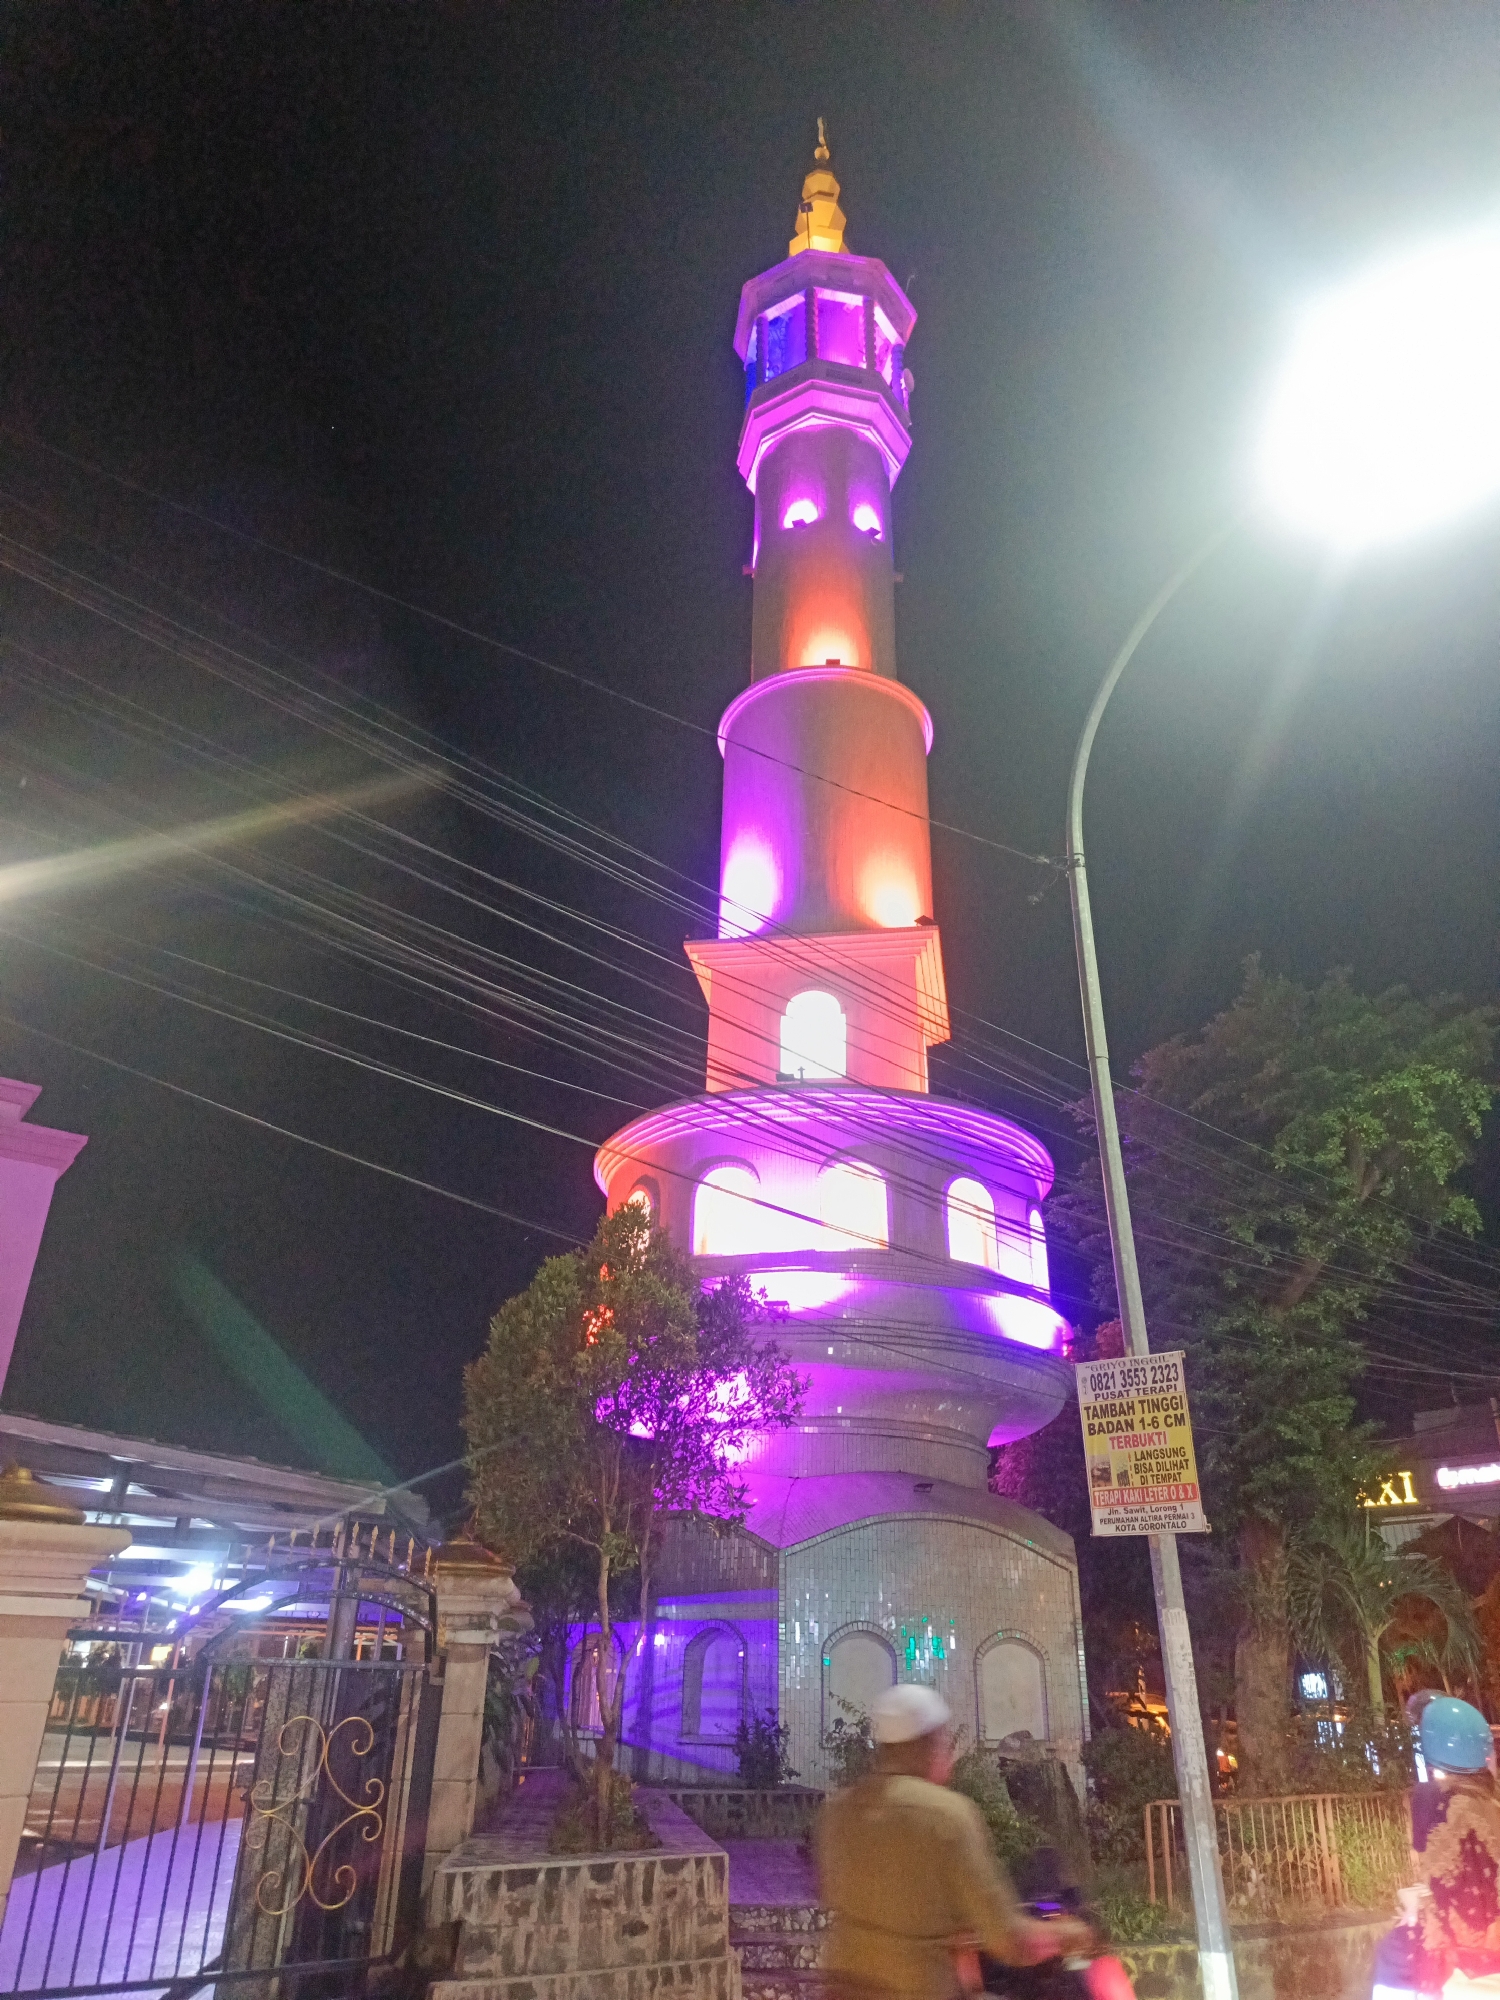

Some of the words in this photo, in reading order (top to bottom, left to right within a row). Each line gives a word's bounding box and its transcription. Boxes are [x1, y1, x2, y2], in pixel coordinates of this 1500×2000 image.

[1090, 1371, 1116, 1392] 0821
[1120, 1367, 1147, 1388] 3553
[1151, 1363, 1179, 1384] 2323
[1094, 1389, 1131, 1401] PUSAT
[1135, 1384, 1178, 1396] TERAPI
[1084, 1400, 1135, 1421] TAMBAH
[1138, 1395, 1184, 1414] TINGGI
[1087, 1419, 1135, 1436] BADAN
[1139, 1416, 1160, 1430] 1-6
[1163, 1413, 1186, 1428] CM
[1109, 1431, 1167, 1450] TERBUKTI
[1134, 1446, 1186, 1461] LANGSUNG
[1134, 1463, 1154, 1474] BISA
[1156, 1459, 1189, 1472] DILIHAT
[1140, 1477, 1149, 1485] DI
[1151, 1472, 1182, 1484] TEMPAT
[1094, 1490, 1121, 1506] TERAPI
[1125, 1489, 1142, 1503] KAKI
[1145, 1487, 1168, 1502] LETER
[1178, 1486, 1185, 1500] &
[1187, 1484, 1194, 1498] X
[1150, 1504, 1177, 1514] Lorong
[1179, 1503, 1184, 1511] 1
[1100, 1517, 1138, 1525] PERUMAHAN
[1141, 1515, 1163, 1523] ALTIRA
[1165, 1513, 1189, 1521] PERMAI
[1115, 1524, 1136, 1532] KOTA
[1139, 1521, 1187, 1531] GORONTALO
